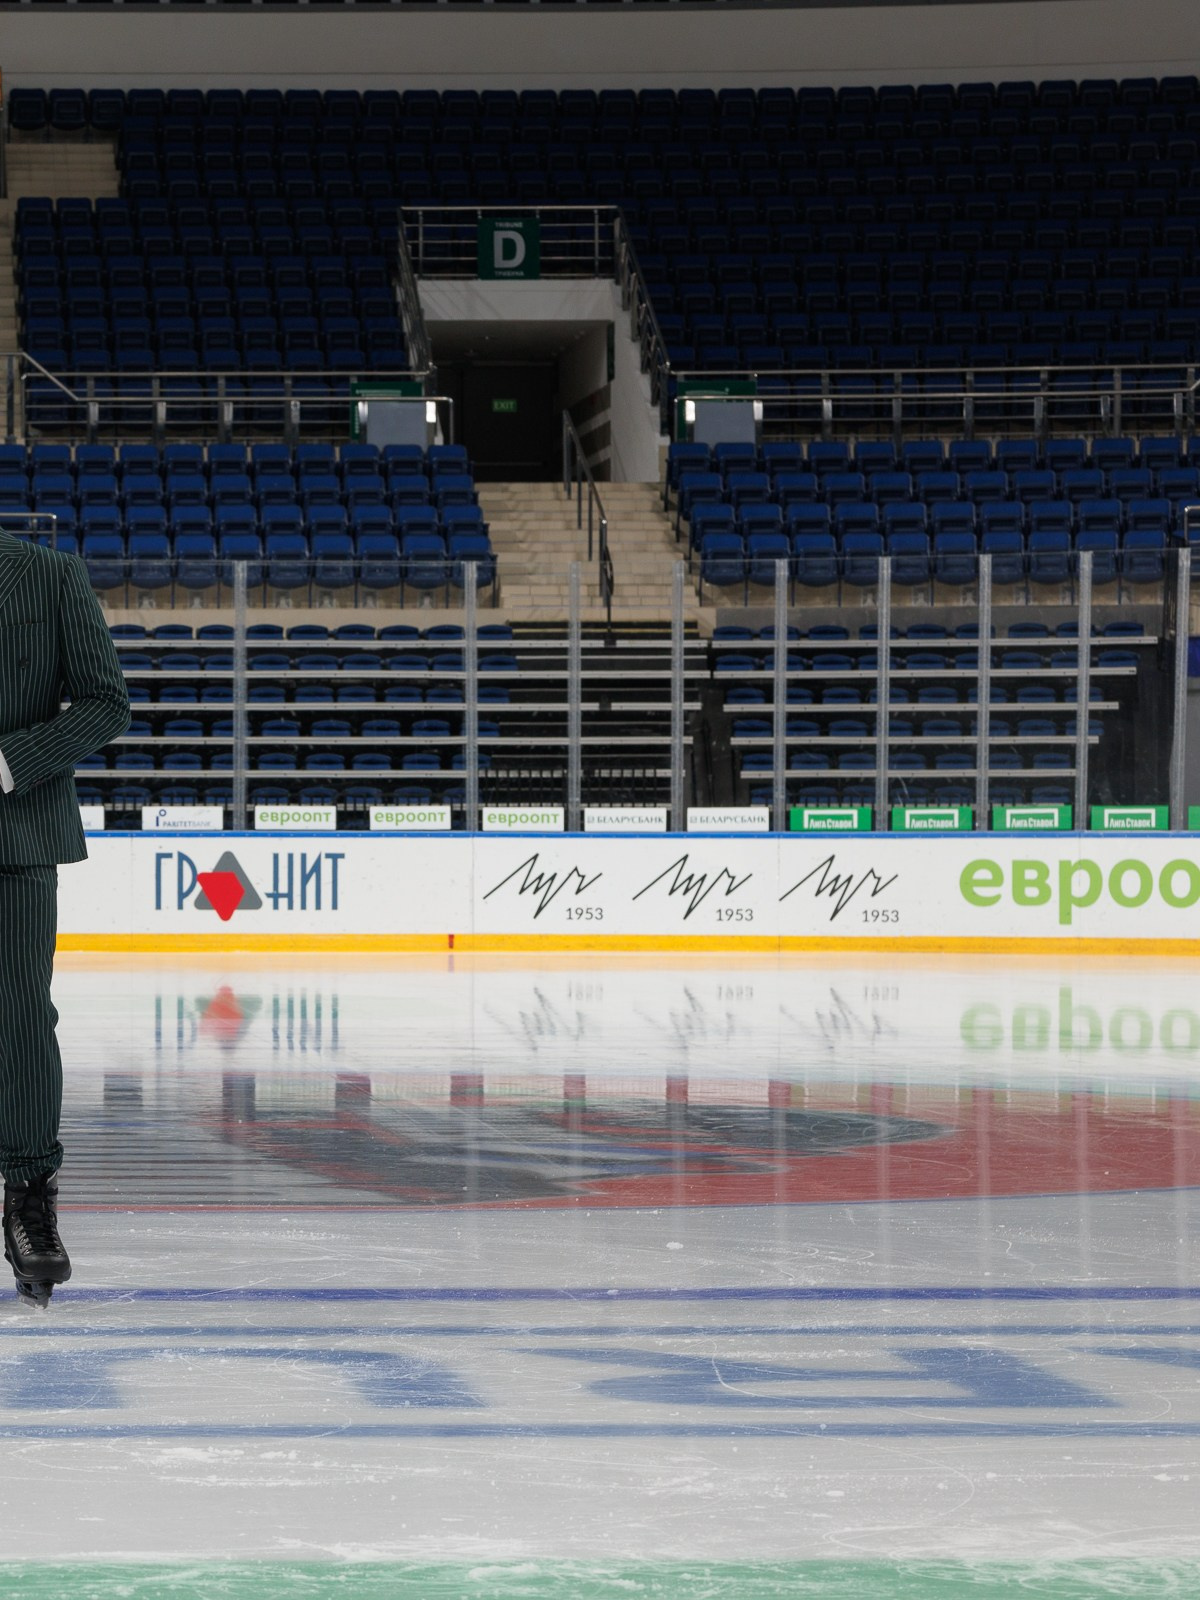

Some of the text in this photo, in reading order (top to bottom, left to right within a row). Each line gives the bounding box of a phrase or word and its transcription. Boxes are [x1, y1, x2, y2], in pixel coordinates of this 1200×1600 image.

[493, 230, 526, 269] D
[259, 810, 332, 826] евроопт
[374, 811, 446, 826] евроопт
[487, 812, 560, 827] евроопт
[597, 815, 664, 824] БЕЛАРУСБАНК
[700, 814, 767, 824] БЕЛАРУСБАНК
[565, 907, 604, 921] 1953
[716, 908, 754, 922] 1953
[862, 909, 900, 923] 1953
